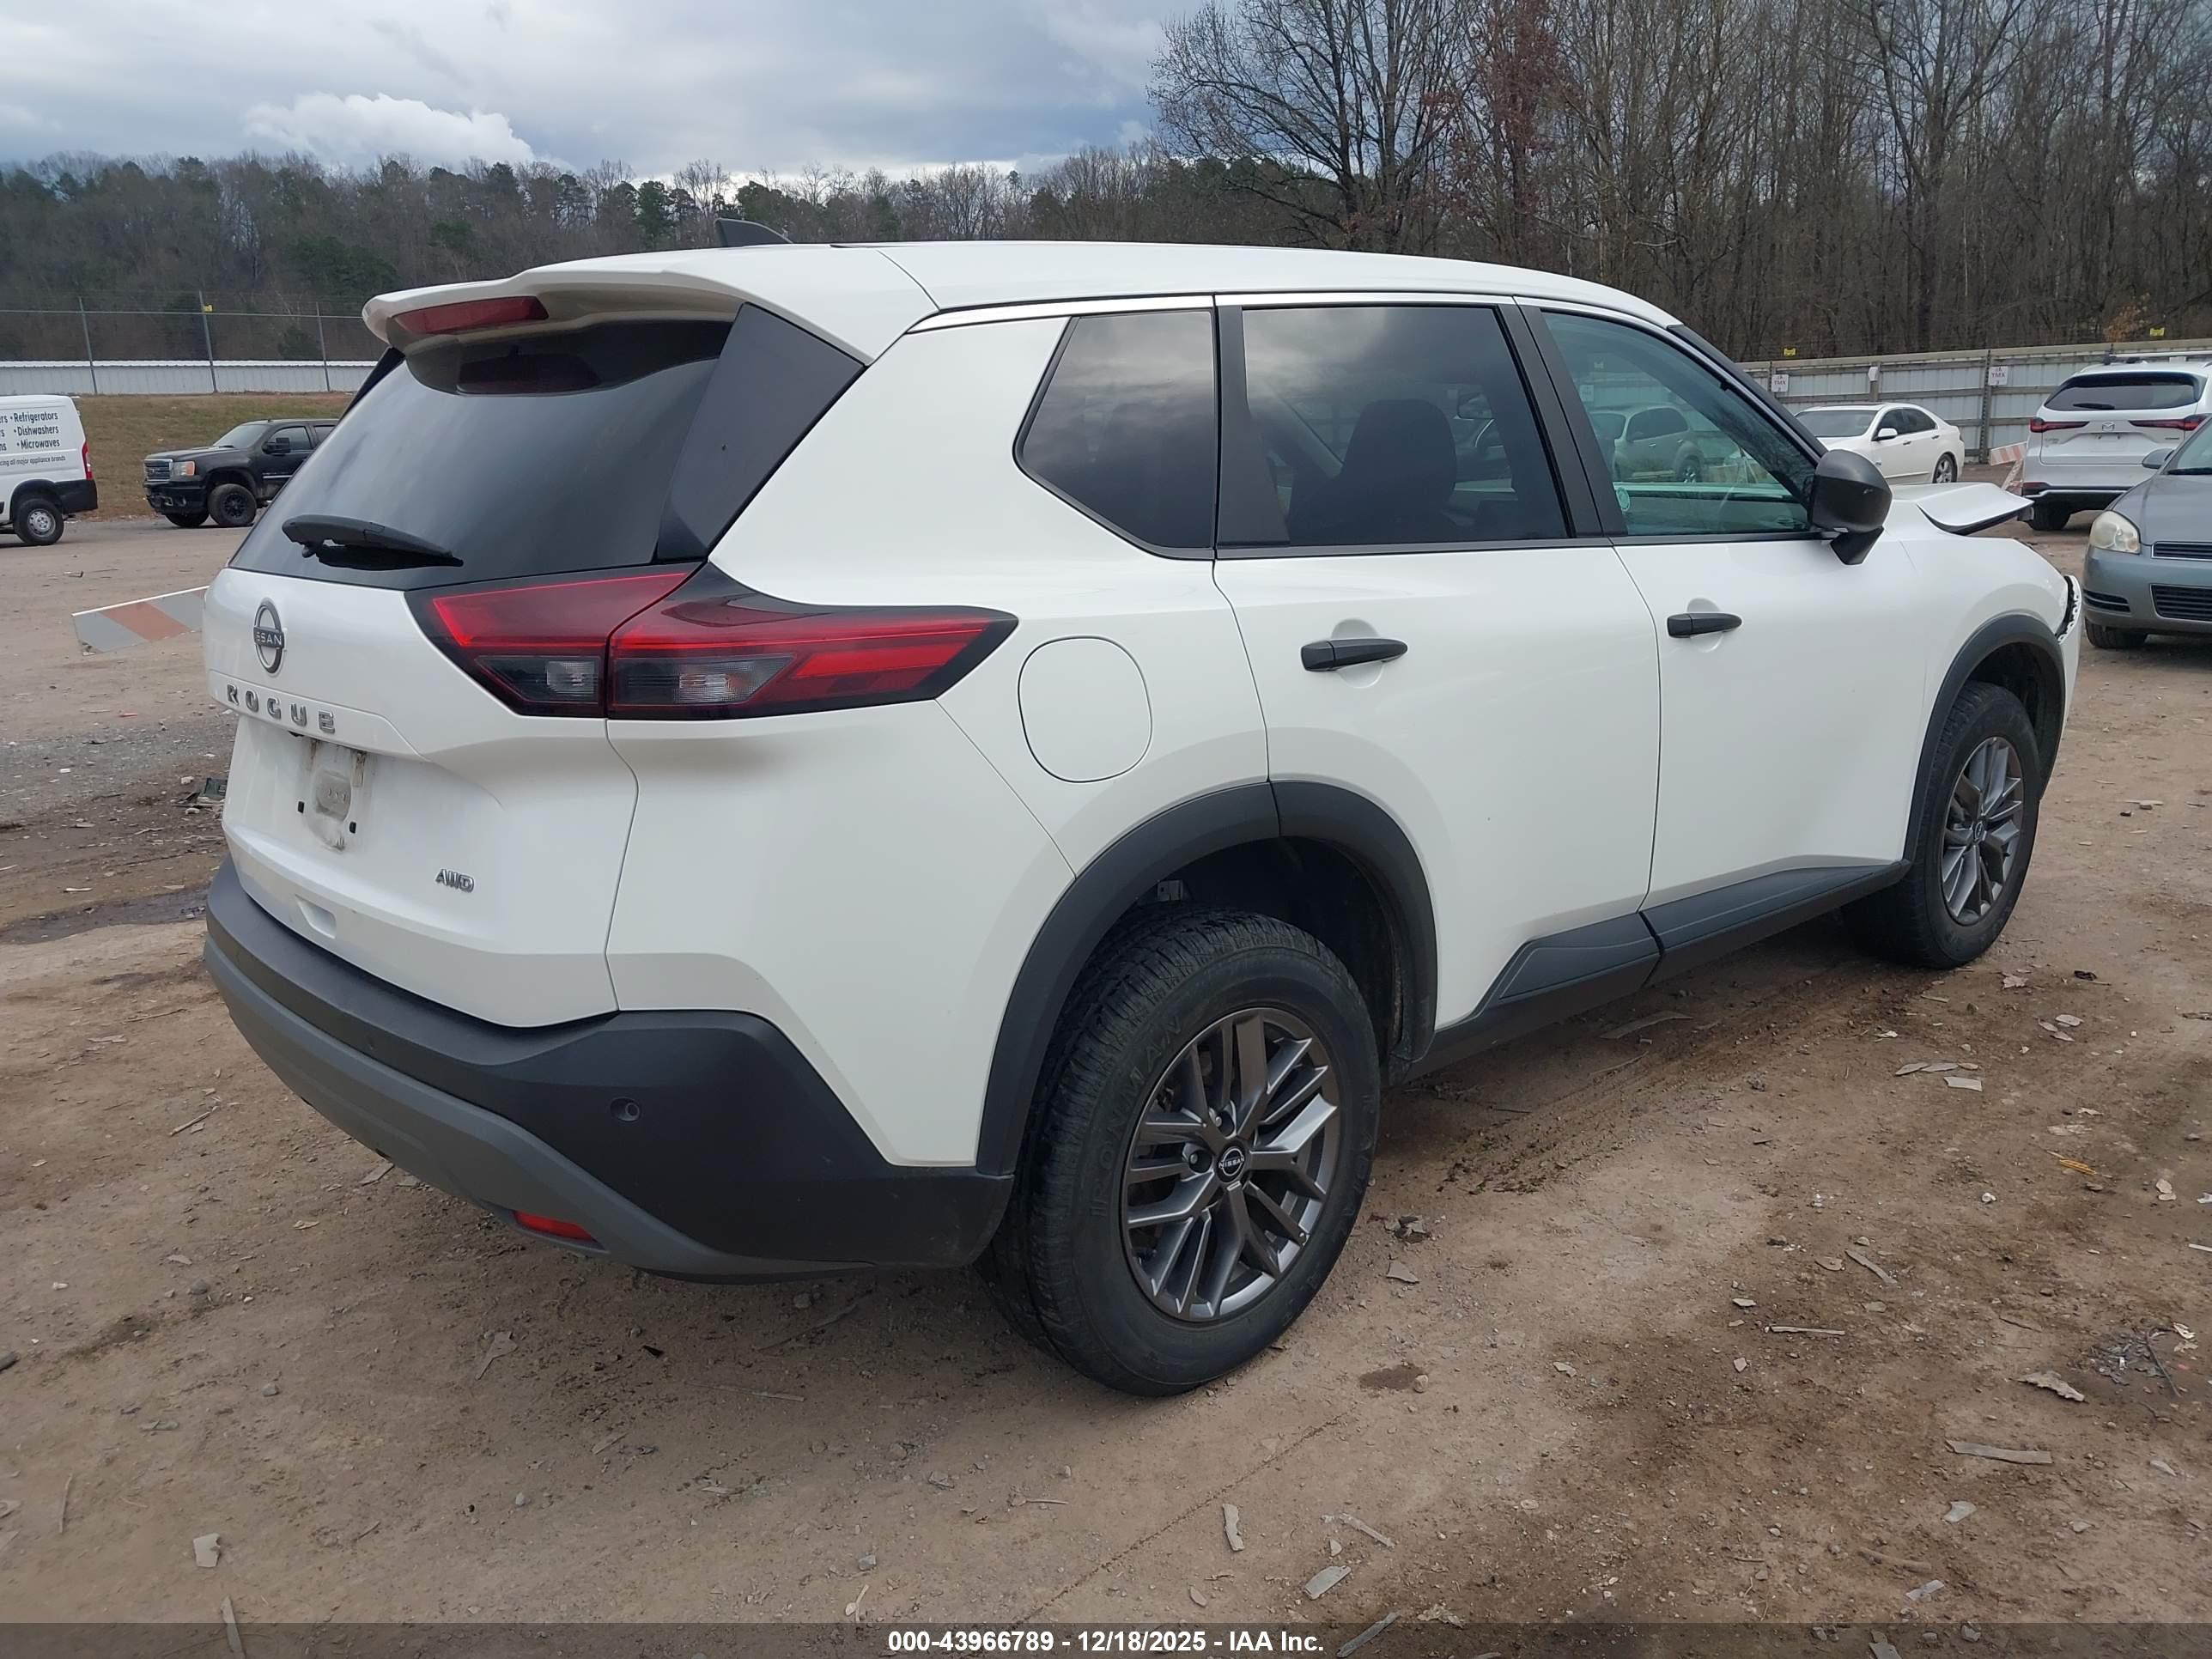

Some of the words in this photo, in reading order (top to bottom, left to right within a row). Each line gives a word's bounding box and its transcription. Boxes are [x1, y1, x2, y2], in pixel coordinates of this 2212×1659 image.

[14, 411, 58, 423] Refrigerators
[17, 425, 59, 435] Dishwashers
[20, 439, 60, 449] Microwaves
[227, 684, 336, 734] ROGUE
[434, 868, 475, 894] AWD
[1218, 1157, 1245, 1169] NISSAN
